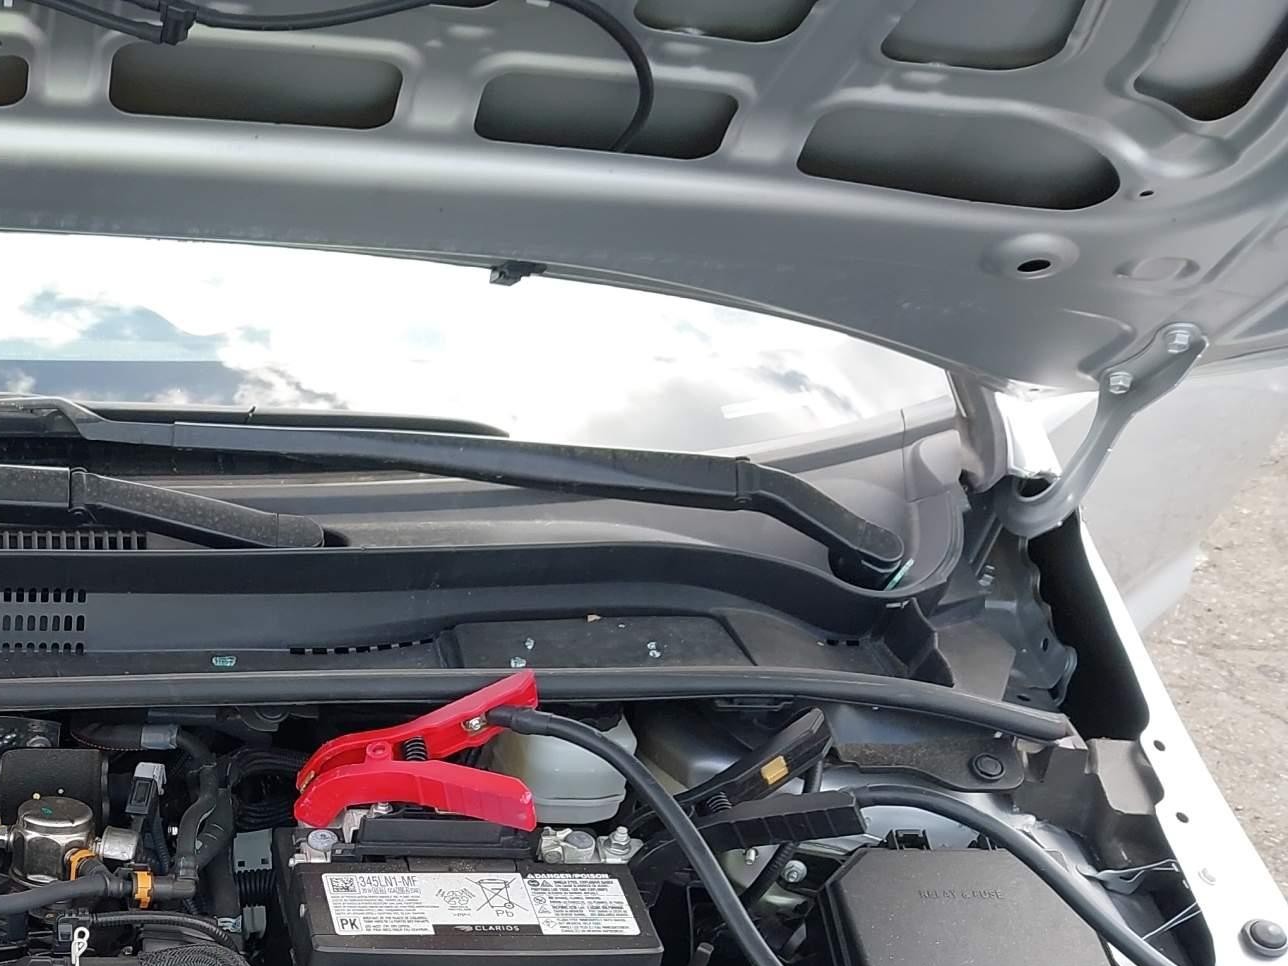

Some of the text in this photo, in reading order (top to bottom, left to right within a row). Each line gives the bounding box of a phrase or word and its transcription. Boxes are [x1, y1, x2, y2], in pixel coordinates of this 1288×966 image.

[358, 875, 417, 888] 345LN1-MF
[495, 909, 514, 918] Pb
[340, 918, 360, 930] PK
